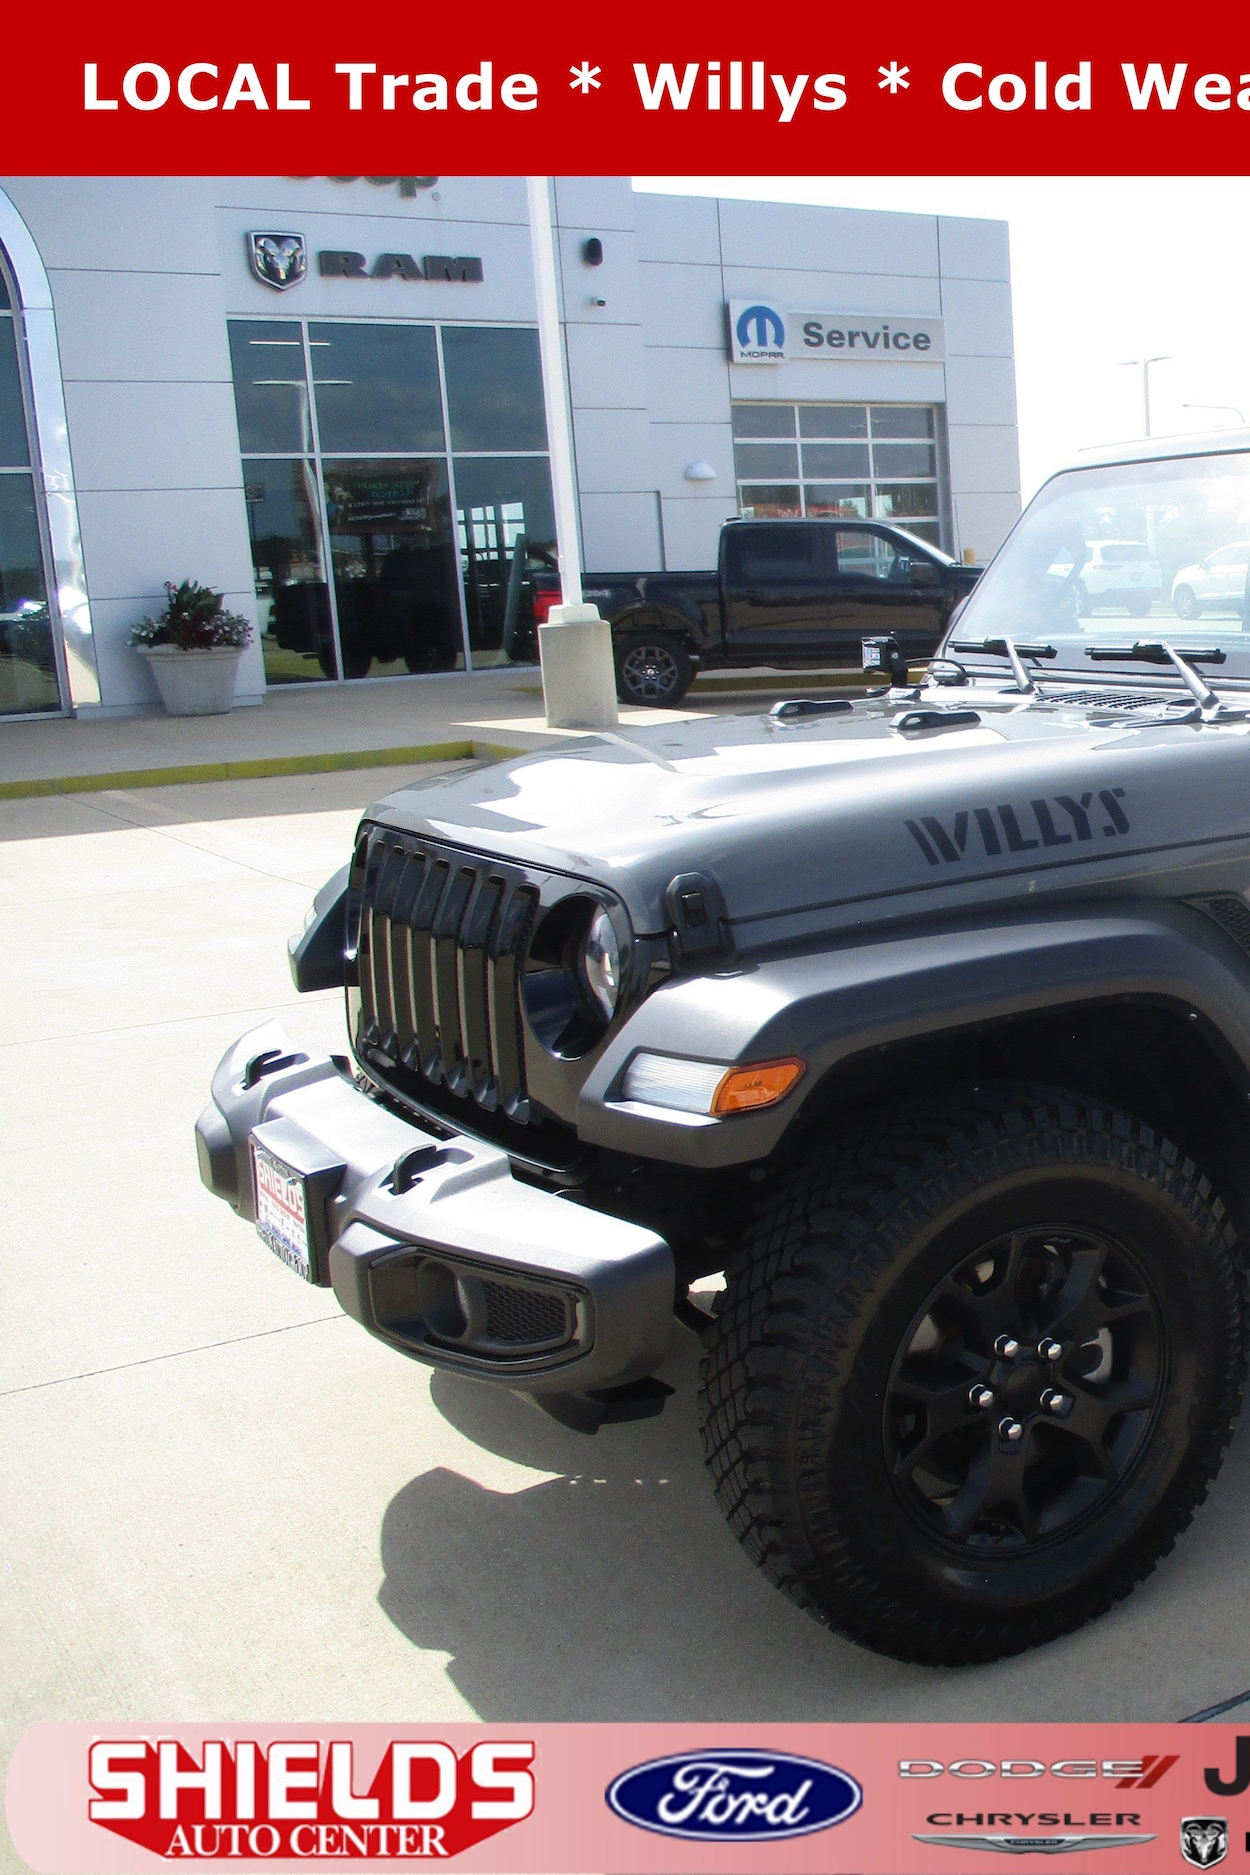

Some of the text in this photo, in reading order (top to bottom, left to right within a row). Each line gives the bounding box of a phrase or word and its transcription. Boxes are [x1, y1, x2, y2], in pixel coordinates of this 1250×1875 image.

[318, 250, 484, 283] RAM
[803, 321, 931, 351] Service
[740, 351, 784, 359] MOPAR
[904, 787, 1131, 866] WILLYS
[258, 1161, 304, 1218] SHIELDS
